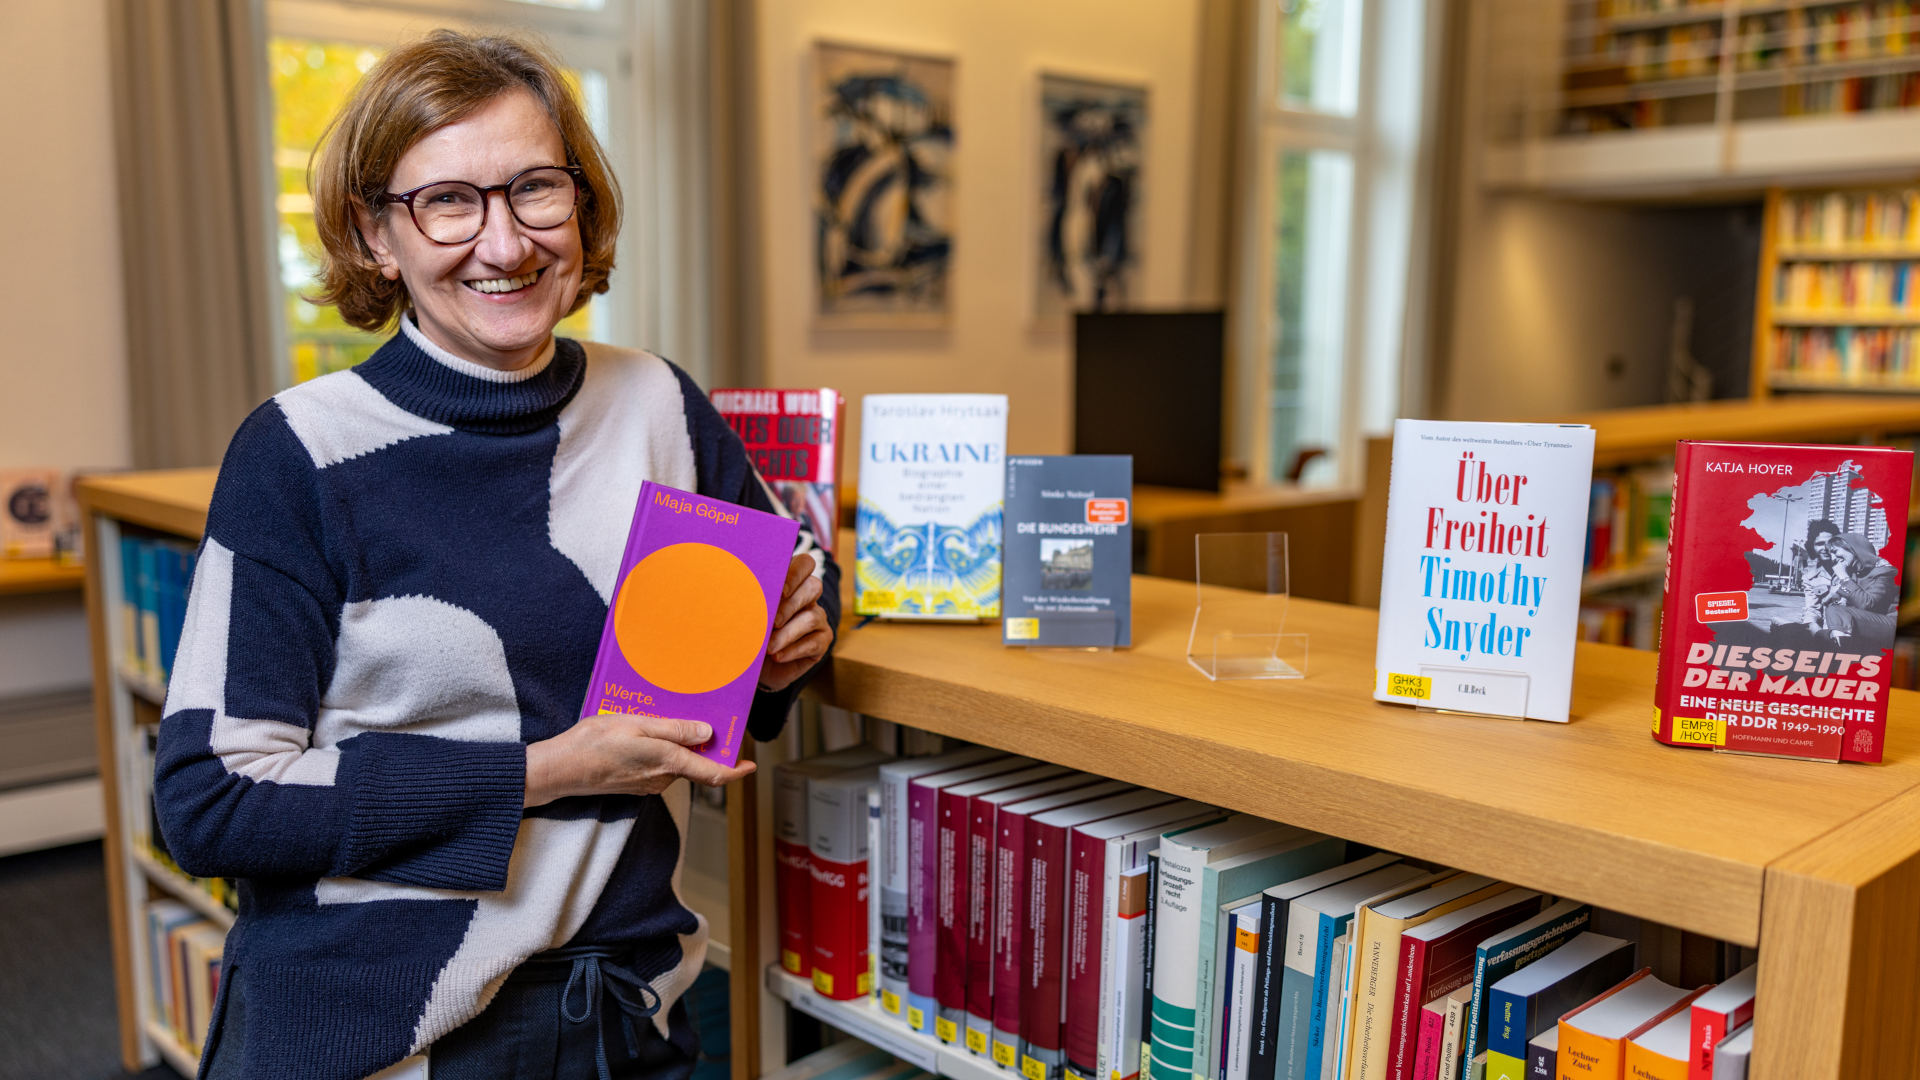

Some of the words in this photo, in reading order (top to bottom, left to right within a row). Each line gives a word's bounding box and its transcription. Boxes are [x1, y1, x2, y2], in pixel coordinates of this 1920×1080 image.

[711, 392, 780, 414] MICHAEL
[872, 405, 936, 417] Yaroslav
[941, 405, 1001, 419] Hrytsak
[778, 417, 832, 444] ODER
[1493, 438, 1523, 447] Bestsellers
[870, 443, 1000, 463] UKRAINE
[1456, 451, 1528, 506] Über
[1706, 462, 1744, 474] KATJA
[1748, 464, 1793, 475] HOYER
[655, 491, 693, 514] Maja
[696, 503, 740, 525] Göpel
[1017, 522, 1037, 534] DIE
[1038, 522, 1118, 535] BUNDESWEHR
[1424, 507, 1550, 558] Freiheit
[1420, 555, 1548, 617] Timothy
[1705, 607, 1741, 616] Bestseller
[1707, 599, 1737, 607] SPIEGEL
[1424, 606, 1531, 662] Snyder
[1686, 642, 1883, 678] DIESSEITS
[1393, 675, 1423, 688] GHK3
[1682, 667, 1752, 692] DER
[1758, 672, 1880, 702] MAUER
[604, 682, 656, 707] Werte.
[1392, 686, 1425, 698] /SYND
[599, 698, 623, 715] Ein
[1679, 695, 1717, 710] EINE
[1719, 698, 1765, 713] NEUE
[1767, 702, 1875, 723] GESCHICHTE
[1681, 720, 1715, 732] EMP8
[1741, 715, 1778, 730] DDR
[1781, 721, 1846, 736] 1949–1990
[1679, 731, 1718, 743] /HOYE
[1732, 733, 1772, 743] HOFFMANN
[1772, 736, 1789, 745] UND
[1789, 738, 1815, 747] CAMPE
[1162, 856, 1192, 873] Pestalozza
[1160, 868, 1195, 886] erfassungs-
[1165, 889, 1182, 900] recht
[1487, 912, 1589, 967] verfassungsgerichtsbarkeit
[1368, 941, 1381, 997] TANNEBERGER
[1475, 956, 1486, 989] führung
[1367, 1003, 1375, 1015] Die
[1396, 993, 1411, 1068] Verfassungsgerichtsbarkeit
[1406, 943, 1415, 981] Landesebene
[1471, 987, 1482, 1023] politische
[1505, 1001, 1513, 1023] Reutter
[1469, 1022, 1477, 1039] und
[1702, 1024, 1712, 1050] Praxis
[1445, 1041, 1453, 1063] Politik
[1567, 1046, 1600, 1064] Lechner
[1572, 1058, 1593, 1072] Zuck
